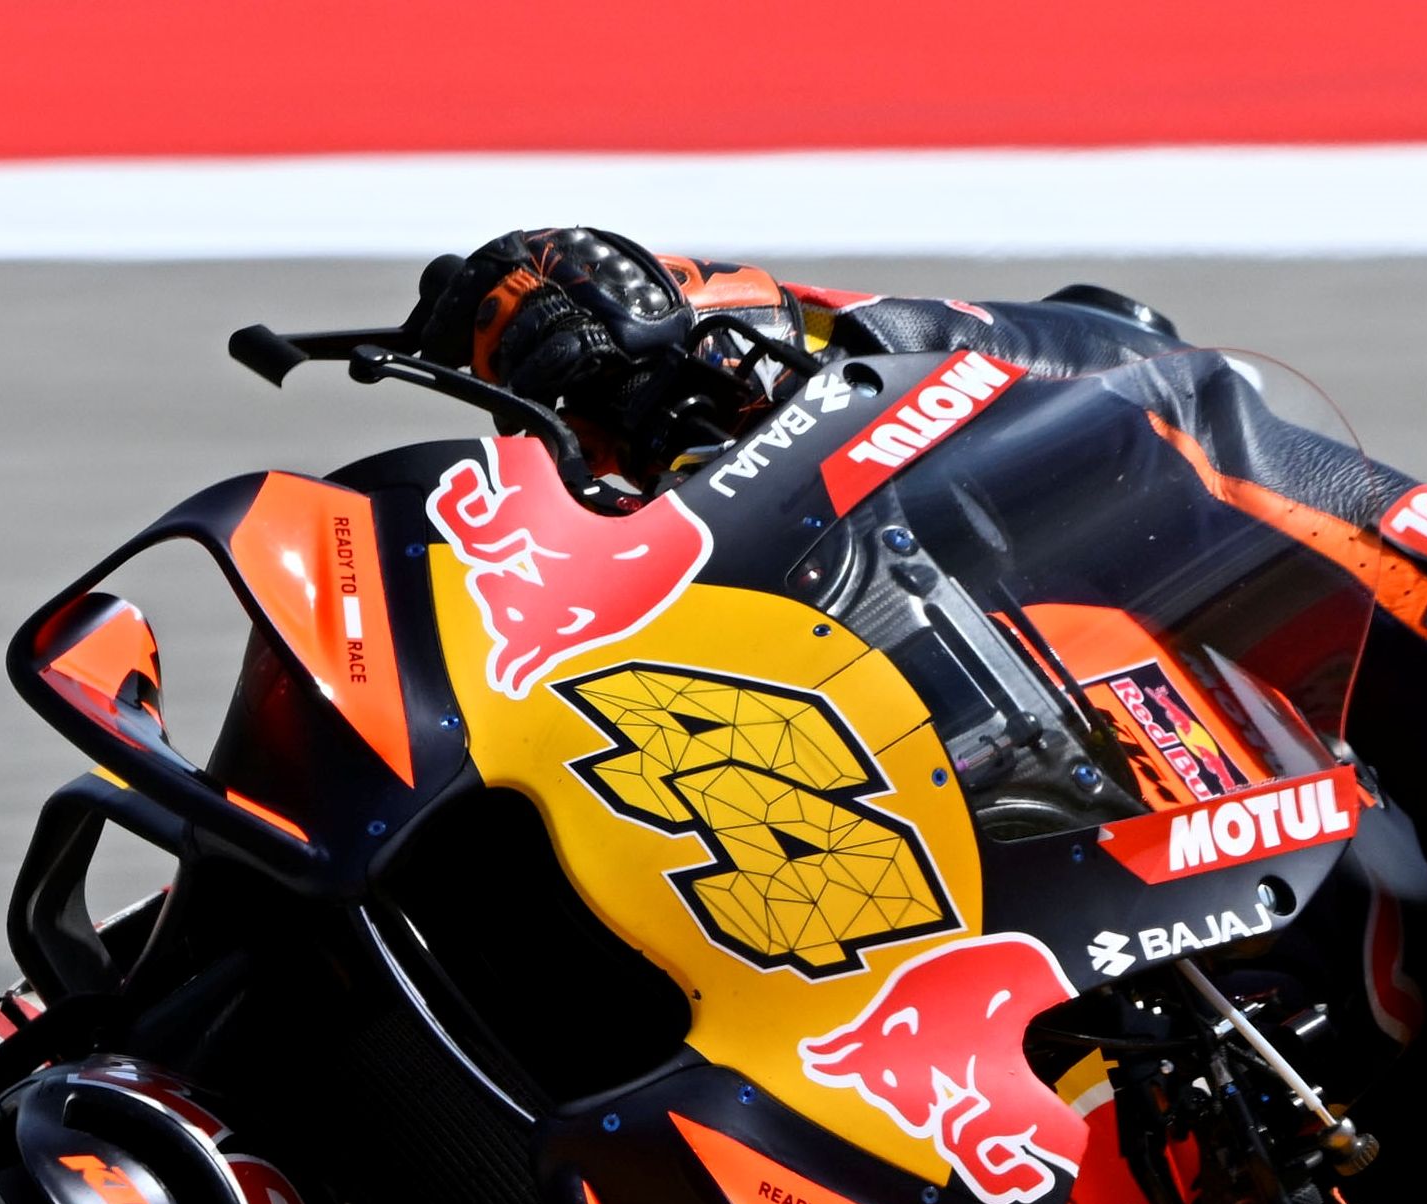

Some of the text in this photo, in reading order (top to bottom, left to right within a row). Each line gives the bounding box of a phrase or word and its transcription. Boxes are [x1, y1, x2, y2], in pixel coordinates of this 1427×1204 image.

[709, 404, 817, 498] BAJAJ
[848, 352, 1010, 467] MOTUL
[334, 515, 367, 684] READY TO RACE
[1109, 677, 1221, 802] Red Bu
[544, 660, 968, 984] 44
[1169, 778, 1351, 873] MOTUL
[1138, 902, 1273, 961] BAJAJ
